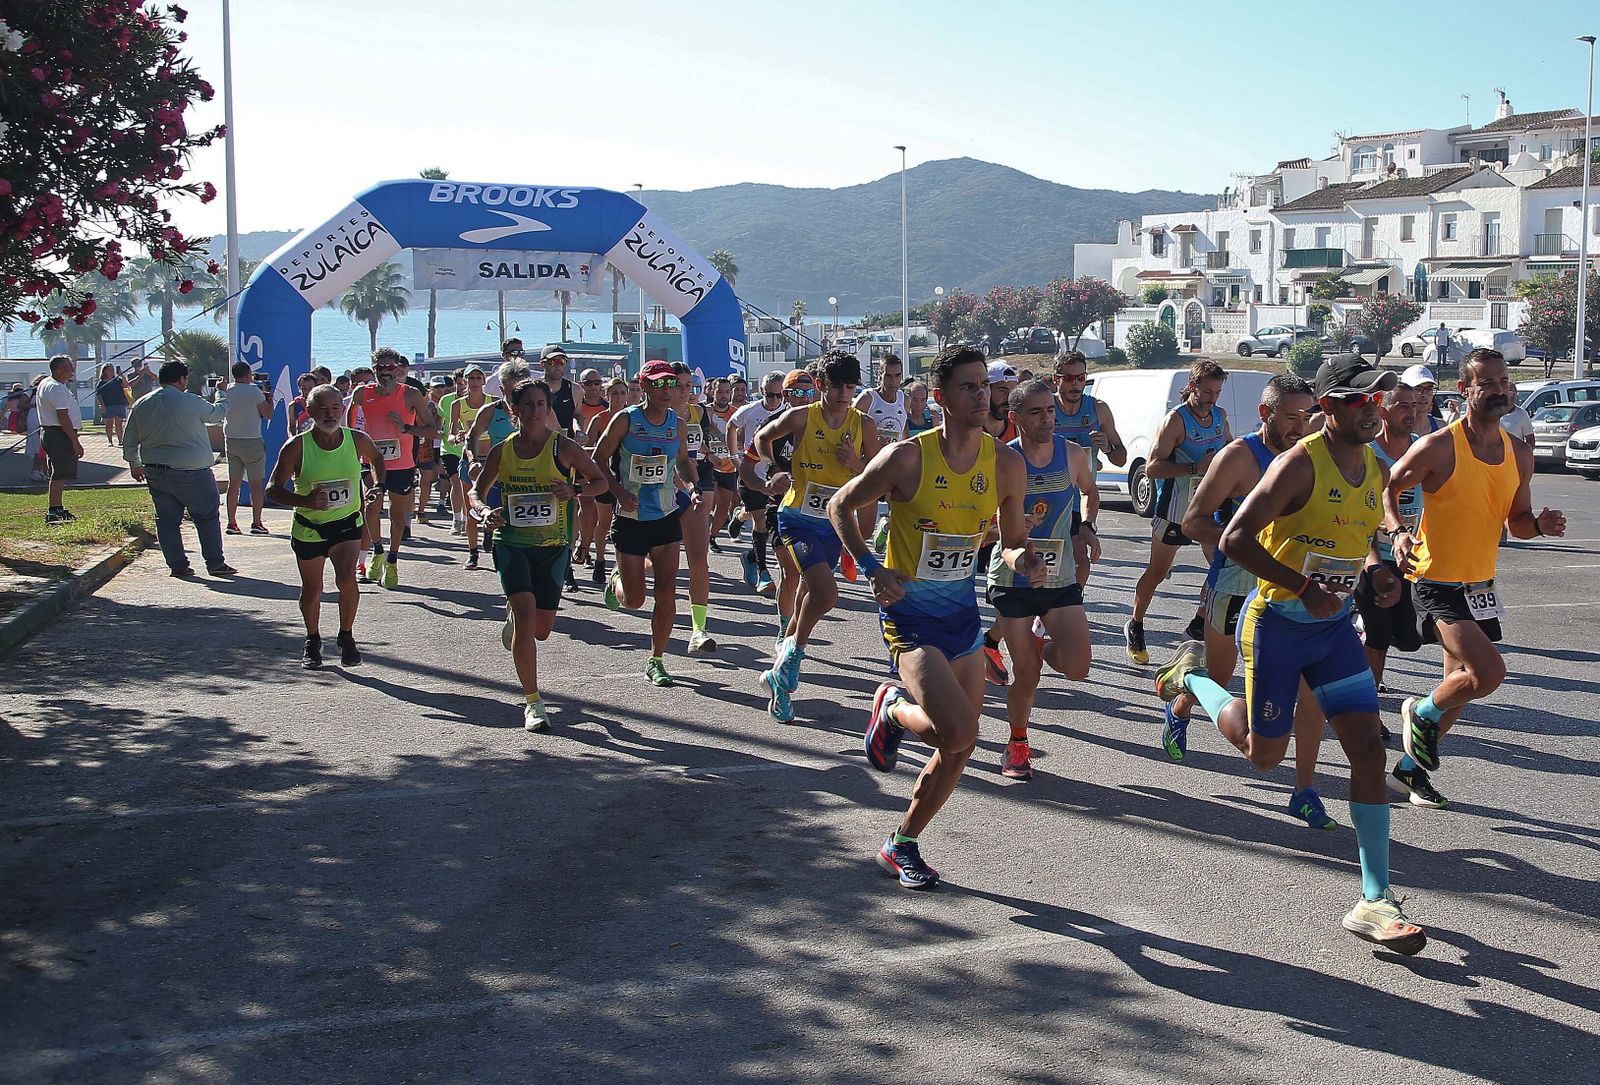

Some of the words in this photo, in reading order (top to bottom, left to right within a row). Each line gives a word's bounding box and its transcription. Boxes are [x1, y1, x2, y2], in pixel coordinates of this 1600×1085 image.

[428, 182, 581, 209] BROOKS
[279, 209, 369, 276] DEPORTES
[637, 221, 714, 288] DEPORTES
[479, 262, 571, 279] SALIDA
[687, 433, 702, 444] 64
[380, 446, 396, 456] 77
[635, 465, 664, 477] 156
[328, 488, 349, 502] 01
[514, 504, 552, 519] 245
[928, 550, 975, 569] 315
[1469, 592, 1497, 610] 339
